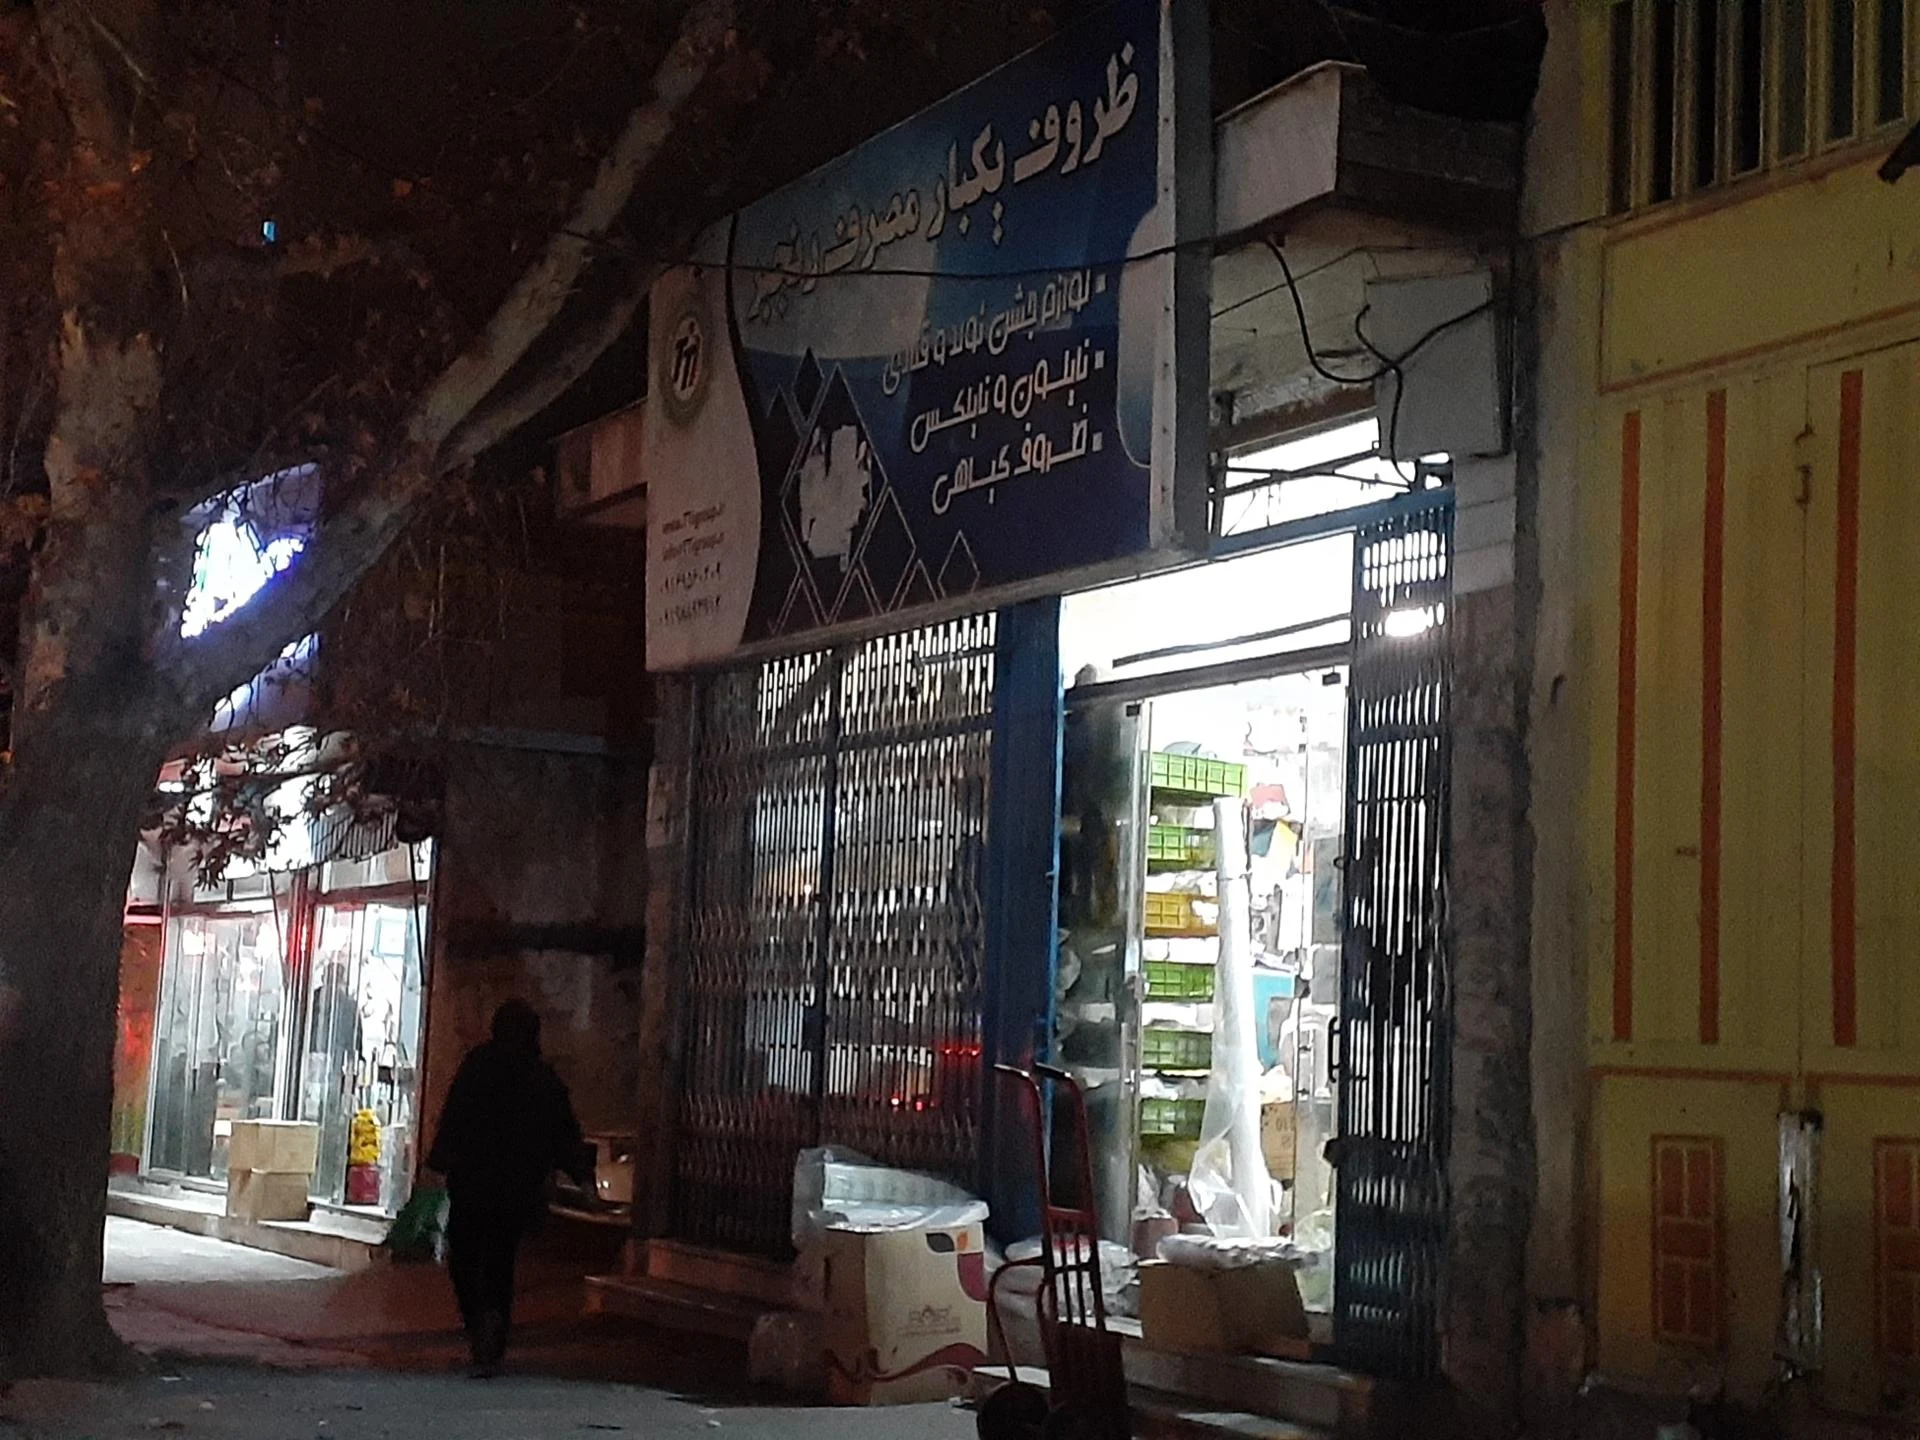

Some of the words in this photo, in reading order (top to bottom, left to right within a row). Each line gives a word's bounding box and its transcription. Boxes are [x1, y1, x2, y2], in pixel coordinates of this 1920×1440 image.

[1014, 42, 1138, 184] ظروف
[926, 123, 1005, 245] یکبار
[824, 189, 921, 273] مصرف
[987, 283, 1037, 356] جشن
[1042, 268, 1091, 326] لوازم
[933, 328, 946, 366] و
[1011, 338, 1090, 418] نایلون
[910, 375, 990, 453] نایلکس
[993, 374, 1007, 414] و
